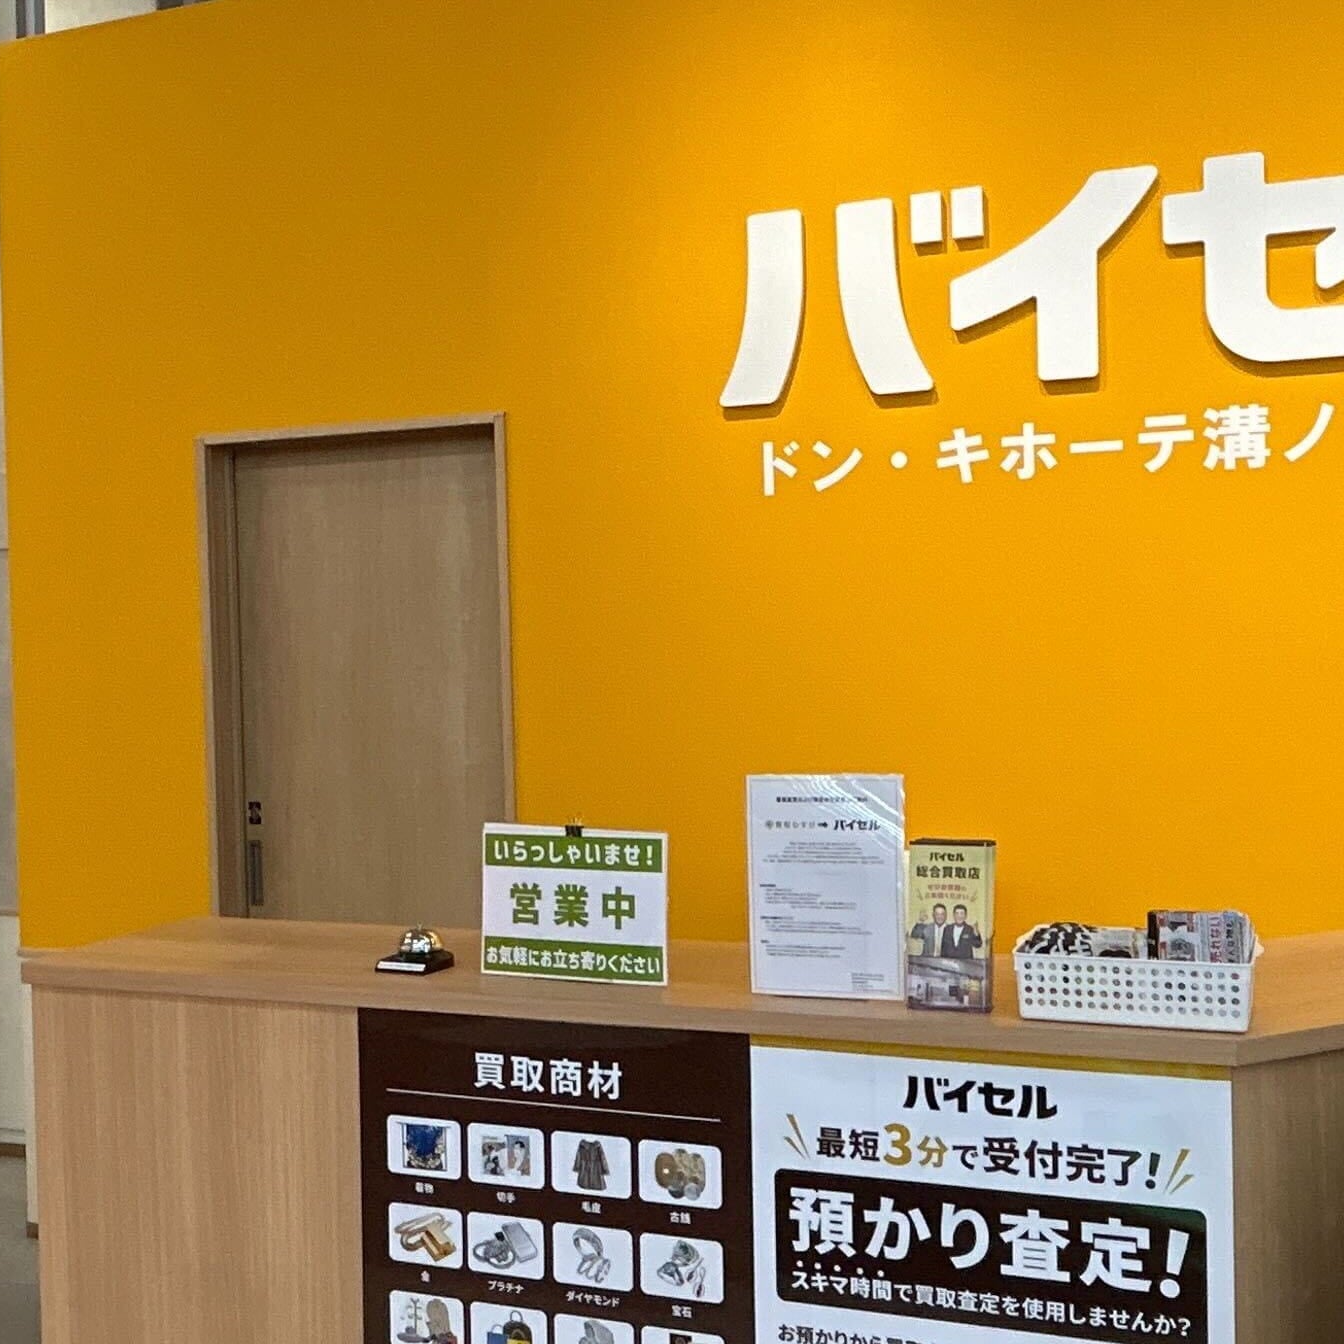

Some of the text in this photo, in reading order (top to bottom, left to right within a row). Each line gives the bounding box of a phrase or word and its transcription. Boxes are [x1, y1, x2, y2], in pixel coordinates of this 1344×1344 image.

[833, 819, 881, 831] バイセル
[493, 840, 653, 866] いらっしゃいませ!
[929, 852, 964, 862] バイセル
[916, 865, 980, 880] 総合買取店
[510, 882, 636, 930] 営業中
[486, 946, 661, 974] お気軽にお立ち寄りください
[473, 1052, 623, 1100] 買取商材
[903, 1076, 1058, 1119] バイセル
[816, 1123, 1160, 1189] 最短3分で受付完了!
[581, 1201, 601, 1214] 毛皮
[789, 1187, 1190, 1299] 預かり査定!
[488, 1280, 524, 1294] プラチナ
[565, 1290, 619, 1307] ダイヤモンド
[671, 1304, 692, 1318] 宝石
[791, 1271, 1191, 1337] スキマ時間で買取査定を使用しませんか?
